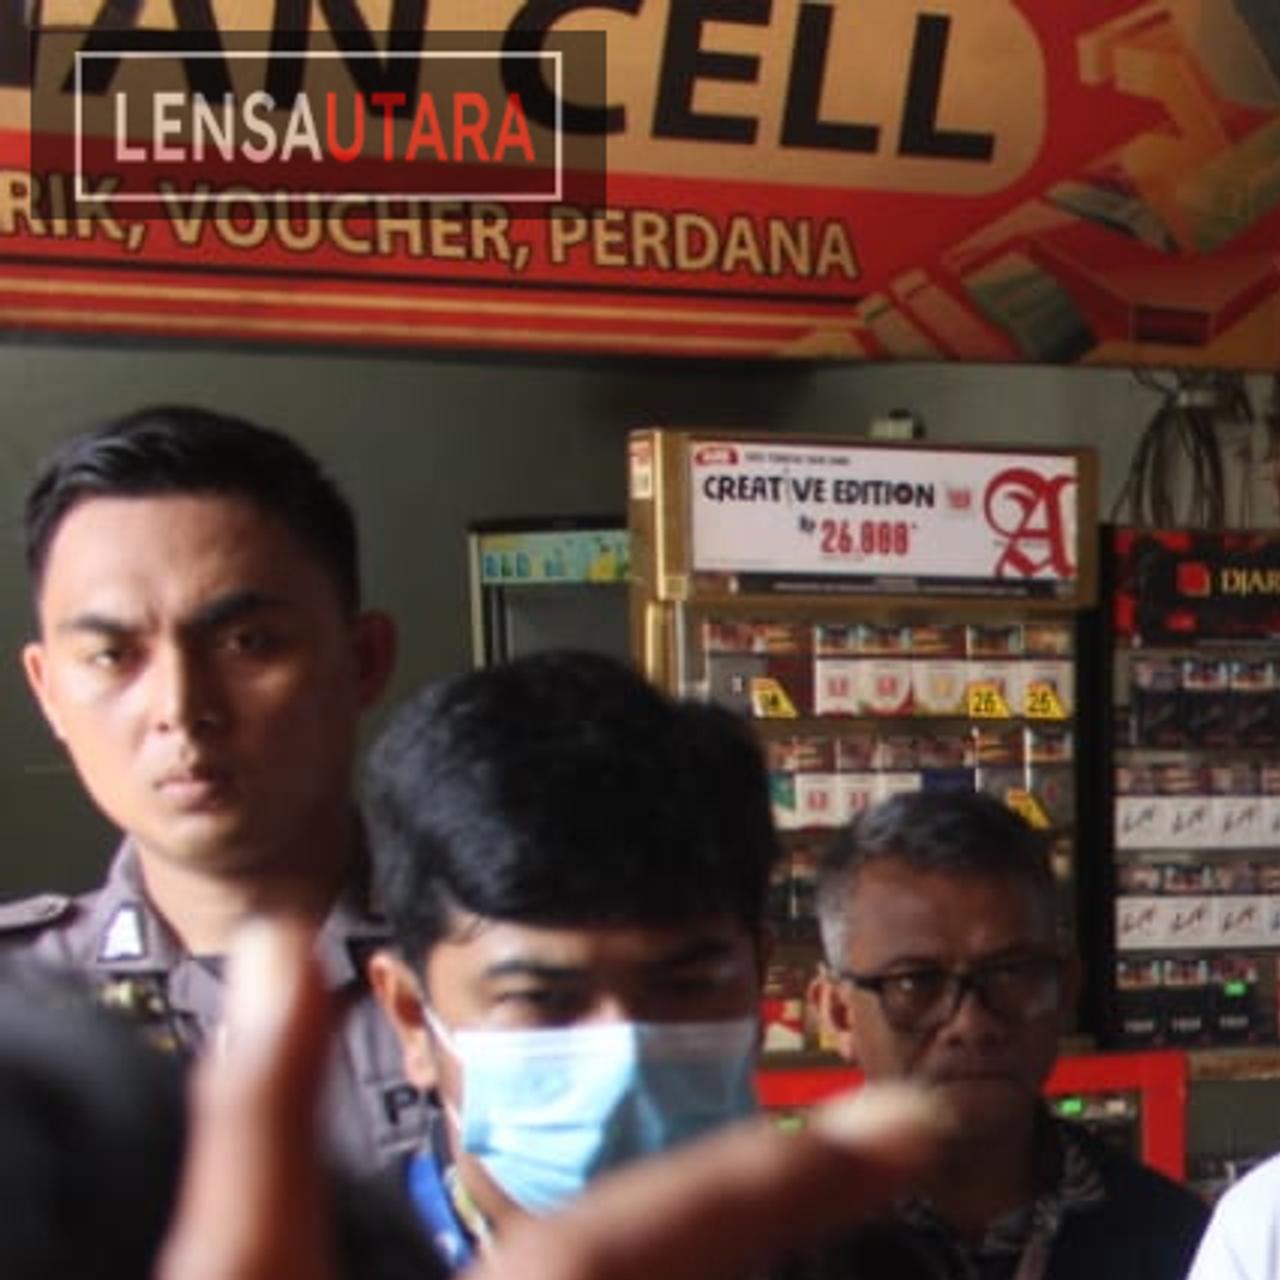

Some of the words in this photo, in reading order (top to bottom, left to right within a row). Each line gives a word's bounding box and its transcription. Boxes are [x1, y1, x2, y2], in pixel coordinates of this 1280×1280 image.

[0, 0, 432, 119] AN
[500, 0, 997, 162] CELL
[159, 178, 530, 272] VOUCHER,
[550, 204, 858, 278] PERDANA
[833, 477, 935, 508] EDITION
